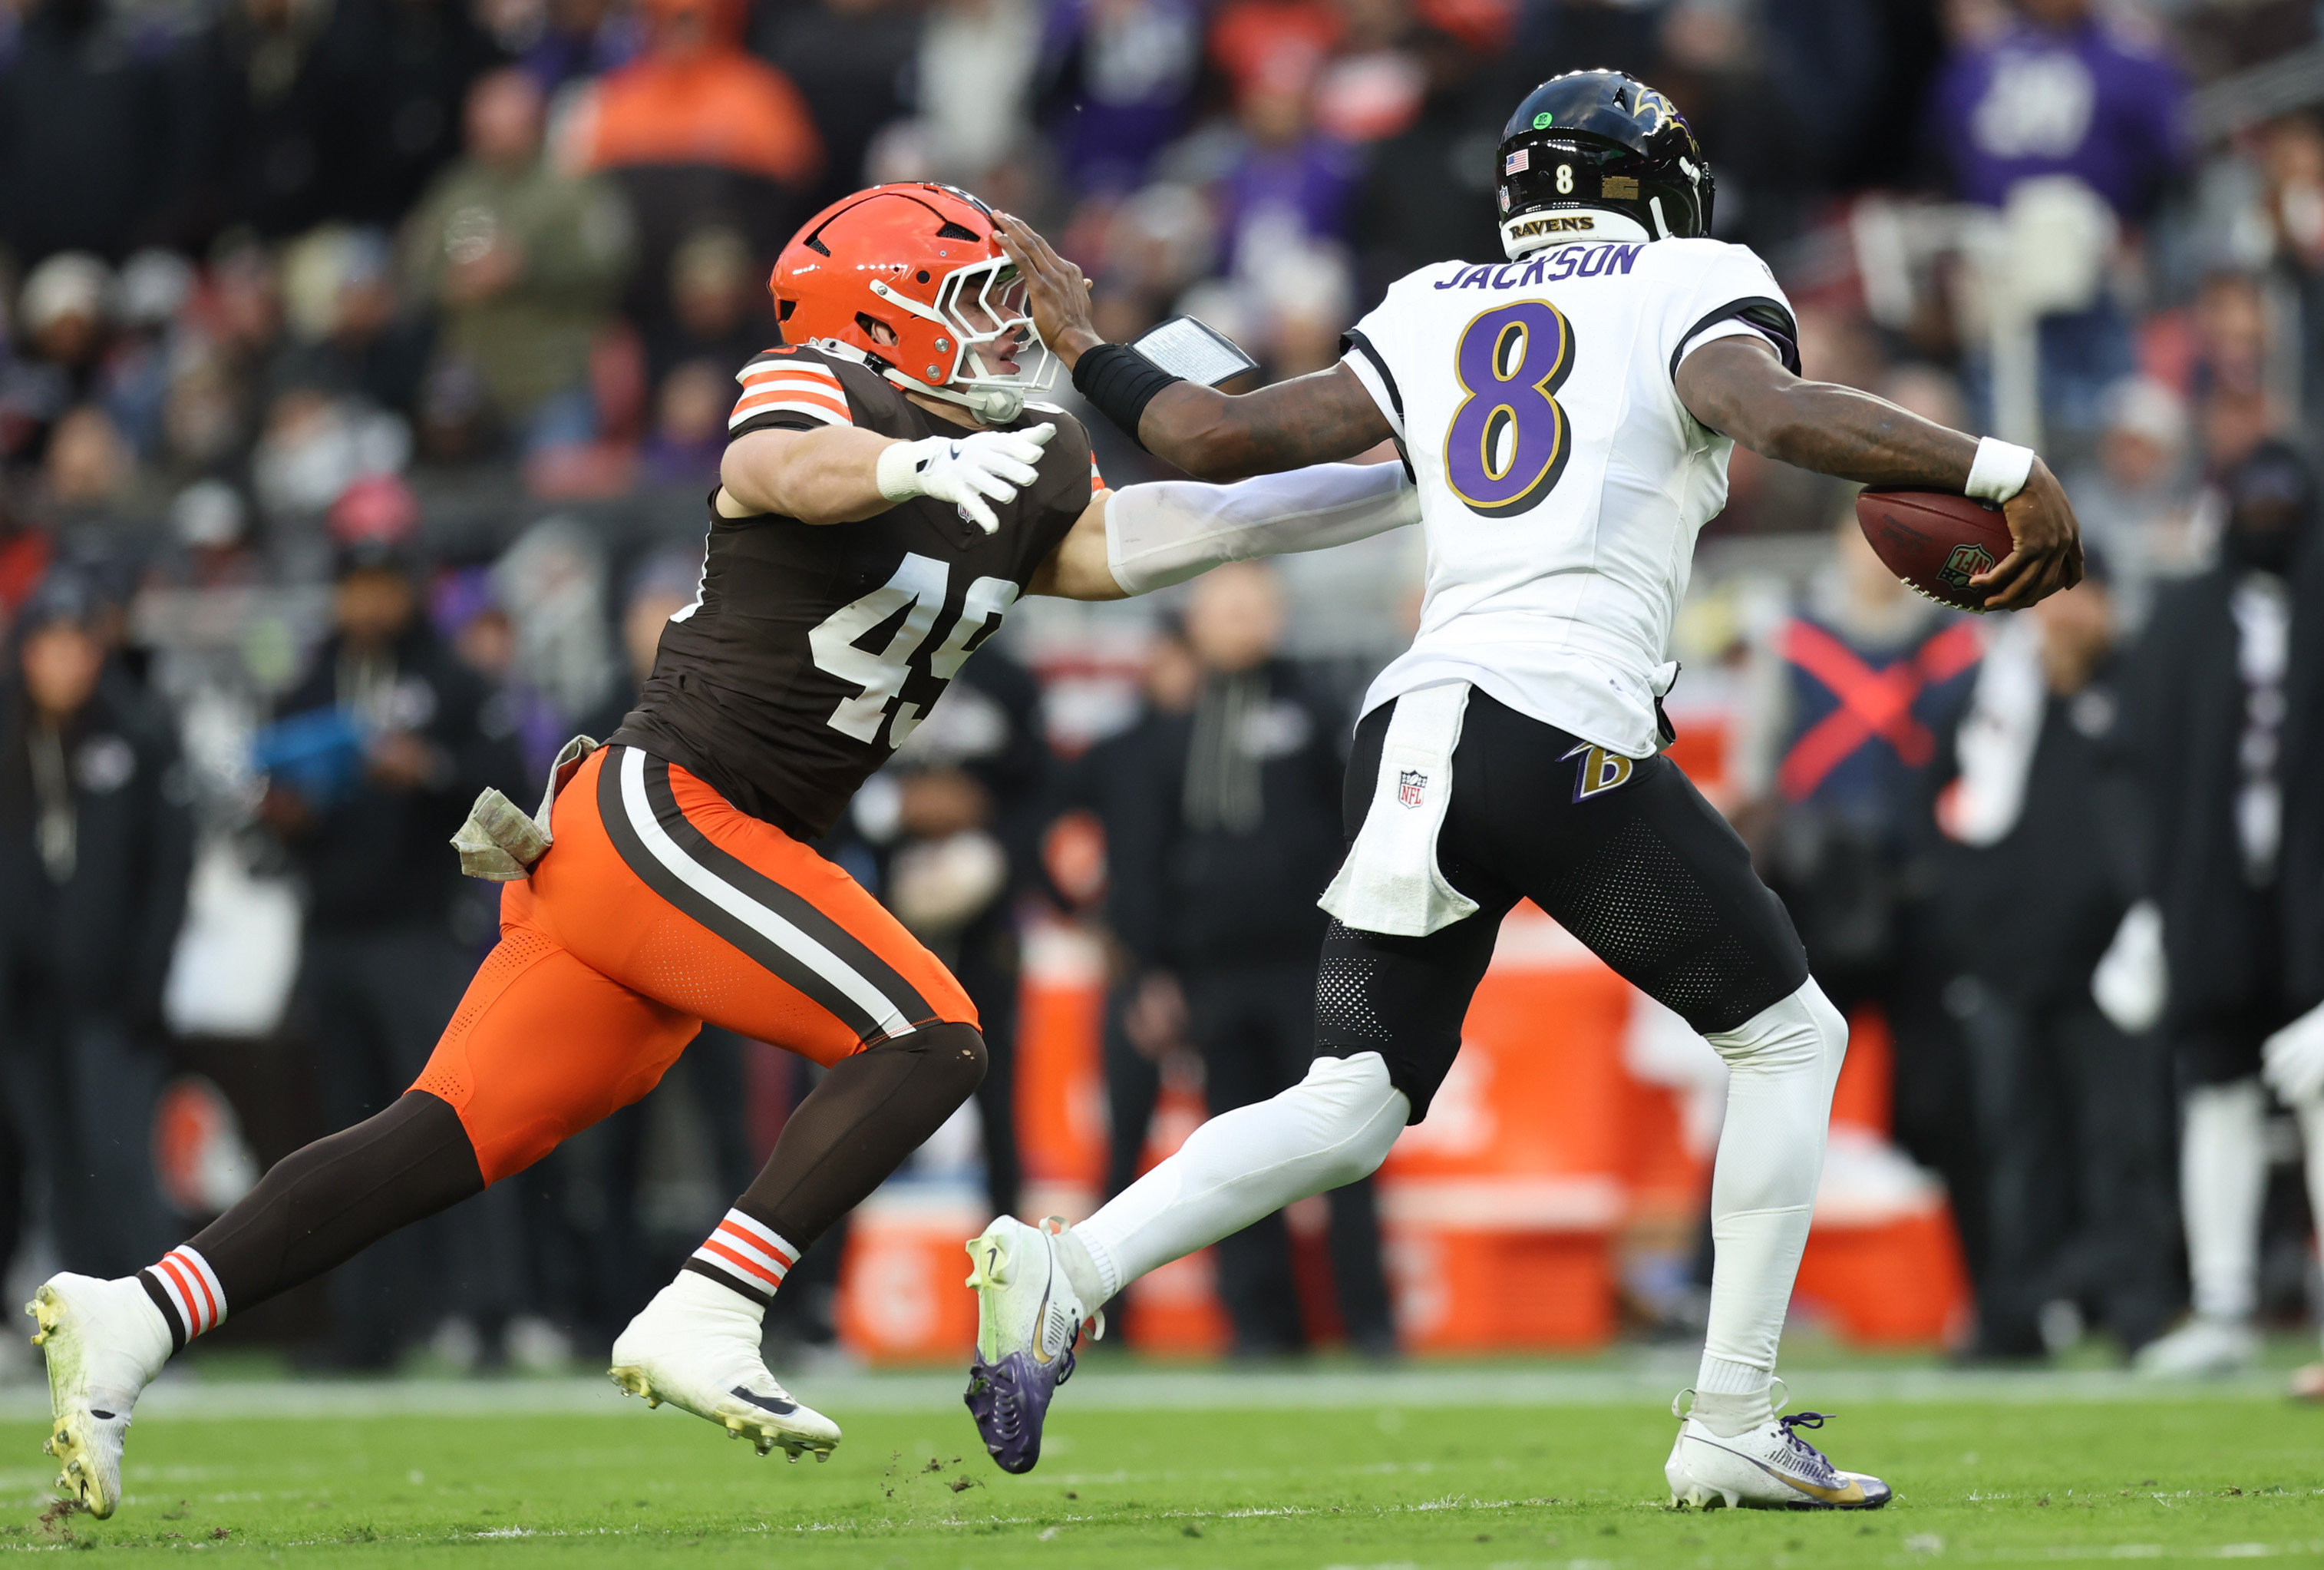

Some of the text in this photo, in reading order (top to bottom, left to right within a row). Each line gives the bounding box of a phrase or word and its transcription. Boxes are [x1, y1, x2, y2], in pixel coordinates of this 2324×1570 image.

[1555, 164, 1574, 194] 8
[1508, 216, 1596, 240] RAVENS
[1434, 244, 1647, 289] JACKSON
[1443, 298, 1576, 518] 8
[1954, 550, 1990, 576] NFL
[1401, 785, 1421, 805] NFL
